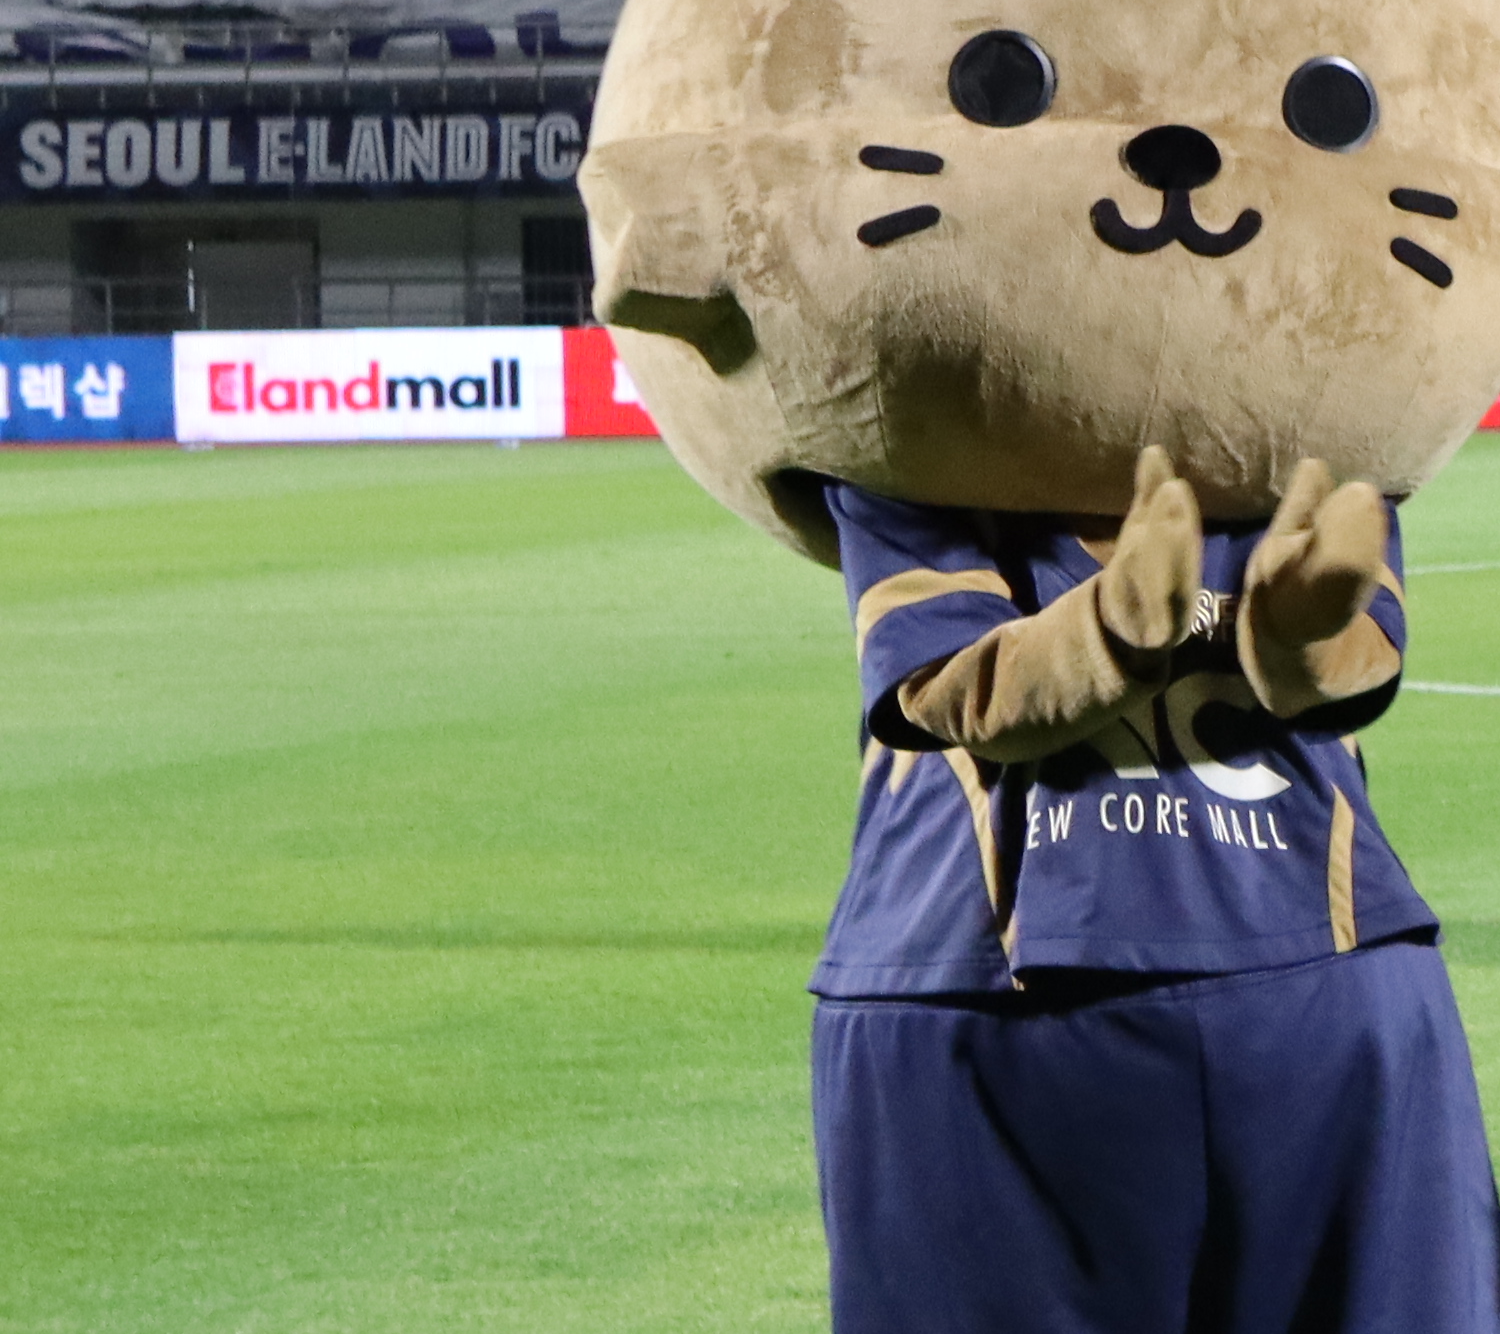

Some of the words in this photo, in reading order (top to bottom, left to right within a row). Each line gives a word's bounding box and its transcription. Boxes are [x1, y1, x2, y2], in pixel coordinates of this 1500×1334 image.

[19, 120, 245, 188] SEOUL
[498, 113, 583, 182] FC
[209, 359, 521, 415] Elandmall
[1027, 800, 1073, 850] EW
[1100, 793, 1189, 839] CORE
[1206, 803, 1289, 851] MALL
